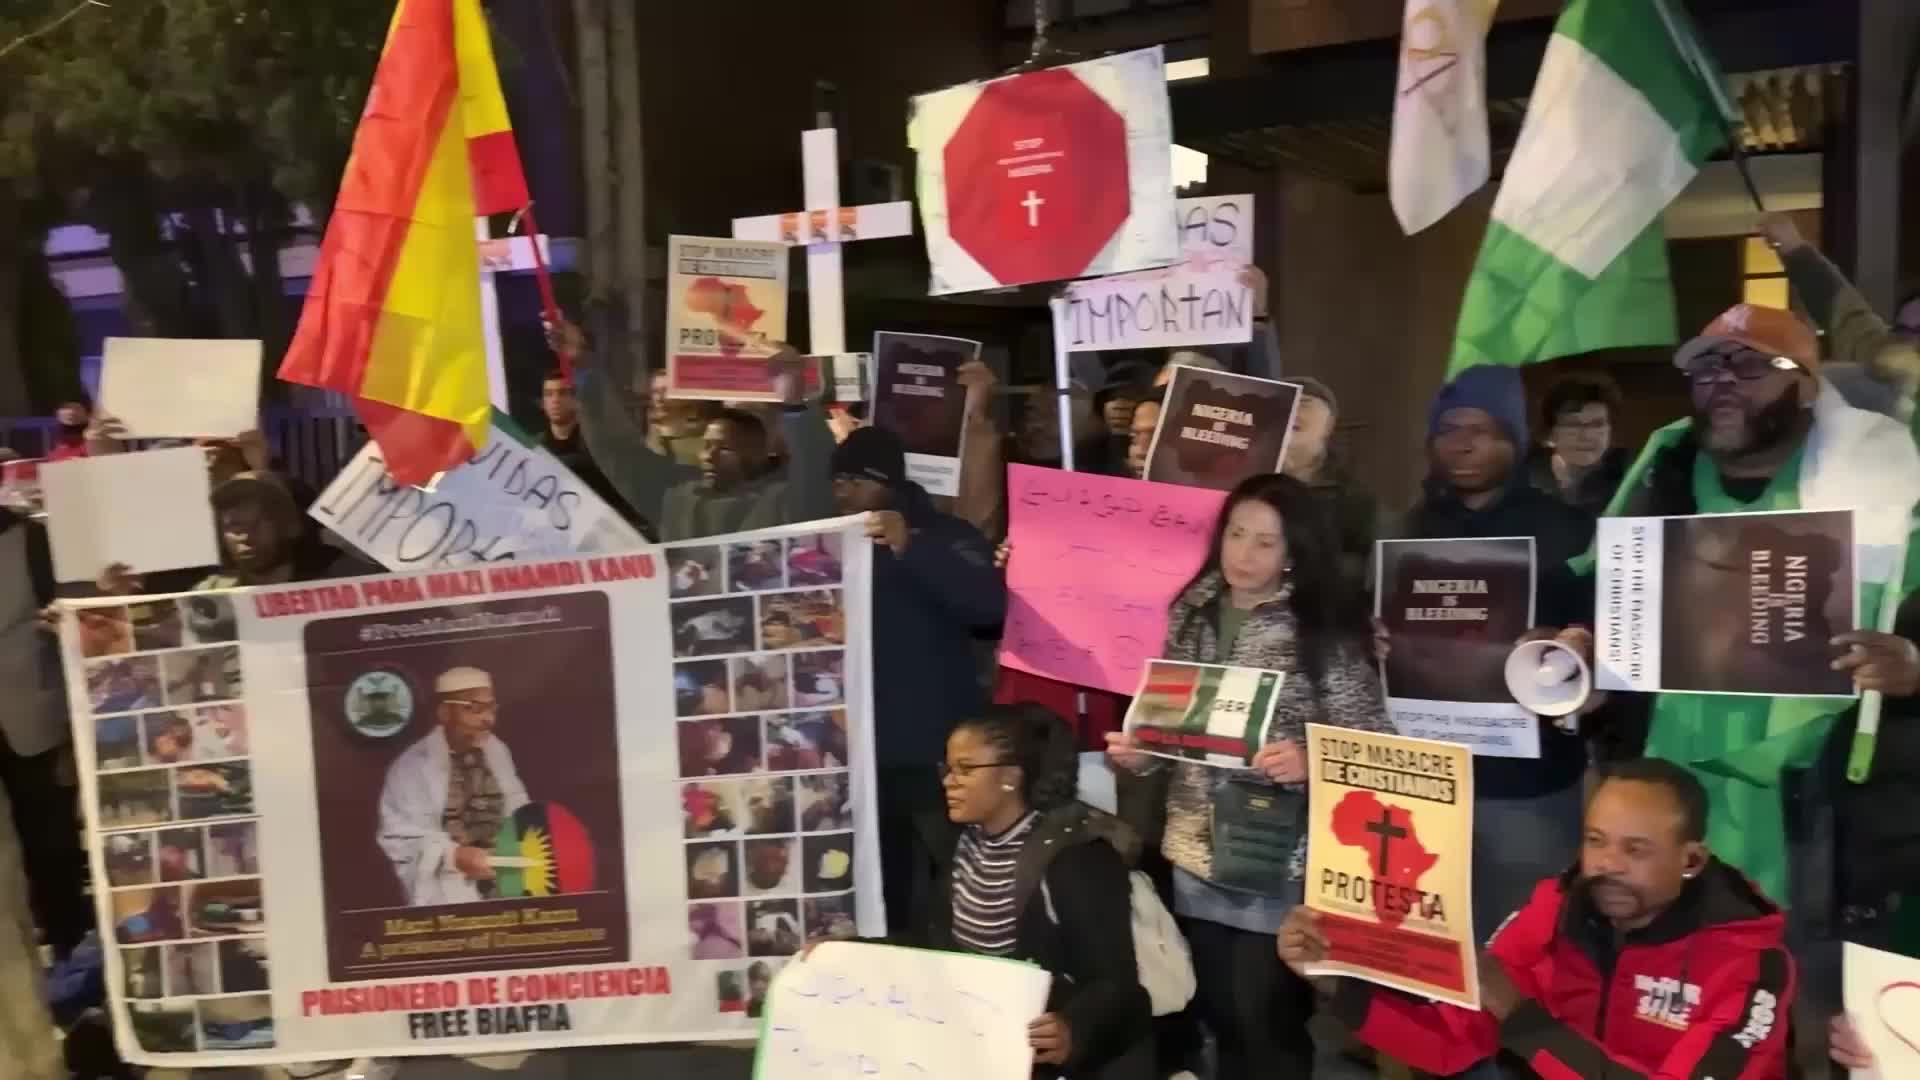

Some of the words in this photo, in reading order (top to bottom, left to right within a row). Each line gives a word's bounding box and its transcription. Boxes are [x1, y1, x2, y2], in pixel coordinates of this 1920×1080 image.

[1068, 284, 1248, 345] IMPORTAN
[589, 553, 657, 583] KANU
[1412, 579, 1489, 594] NIGERIA
[1404, 607, 1489, 621] BLEEDING
[1751, 550, 1771, 644] BLEEDING
[1784, 555, 1809, 642] NIGERIA
[1319, 737, 1361, 759] STOP
[1367, 744, 1456, 776] MASACRE
[1323, 760, 1346, 781] DE
[1347, 766, 1456, 801] CRISTIANOS
[1321, 867, 1447, 922] PROTESTA
[301, 981, 460, 1017] PRISIONERO
[468, 976, 499, 1004] DE
[507, 967, 672, 1002] CONCIENCIA
[408, 1009, 470, 1040] FREE
[477, 1004, 573, 1036] BIAFRA
